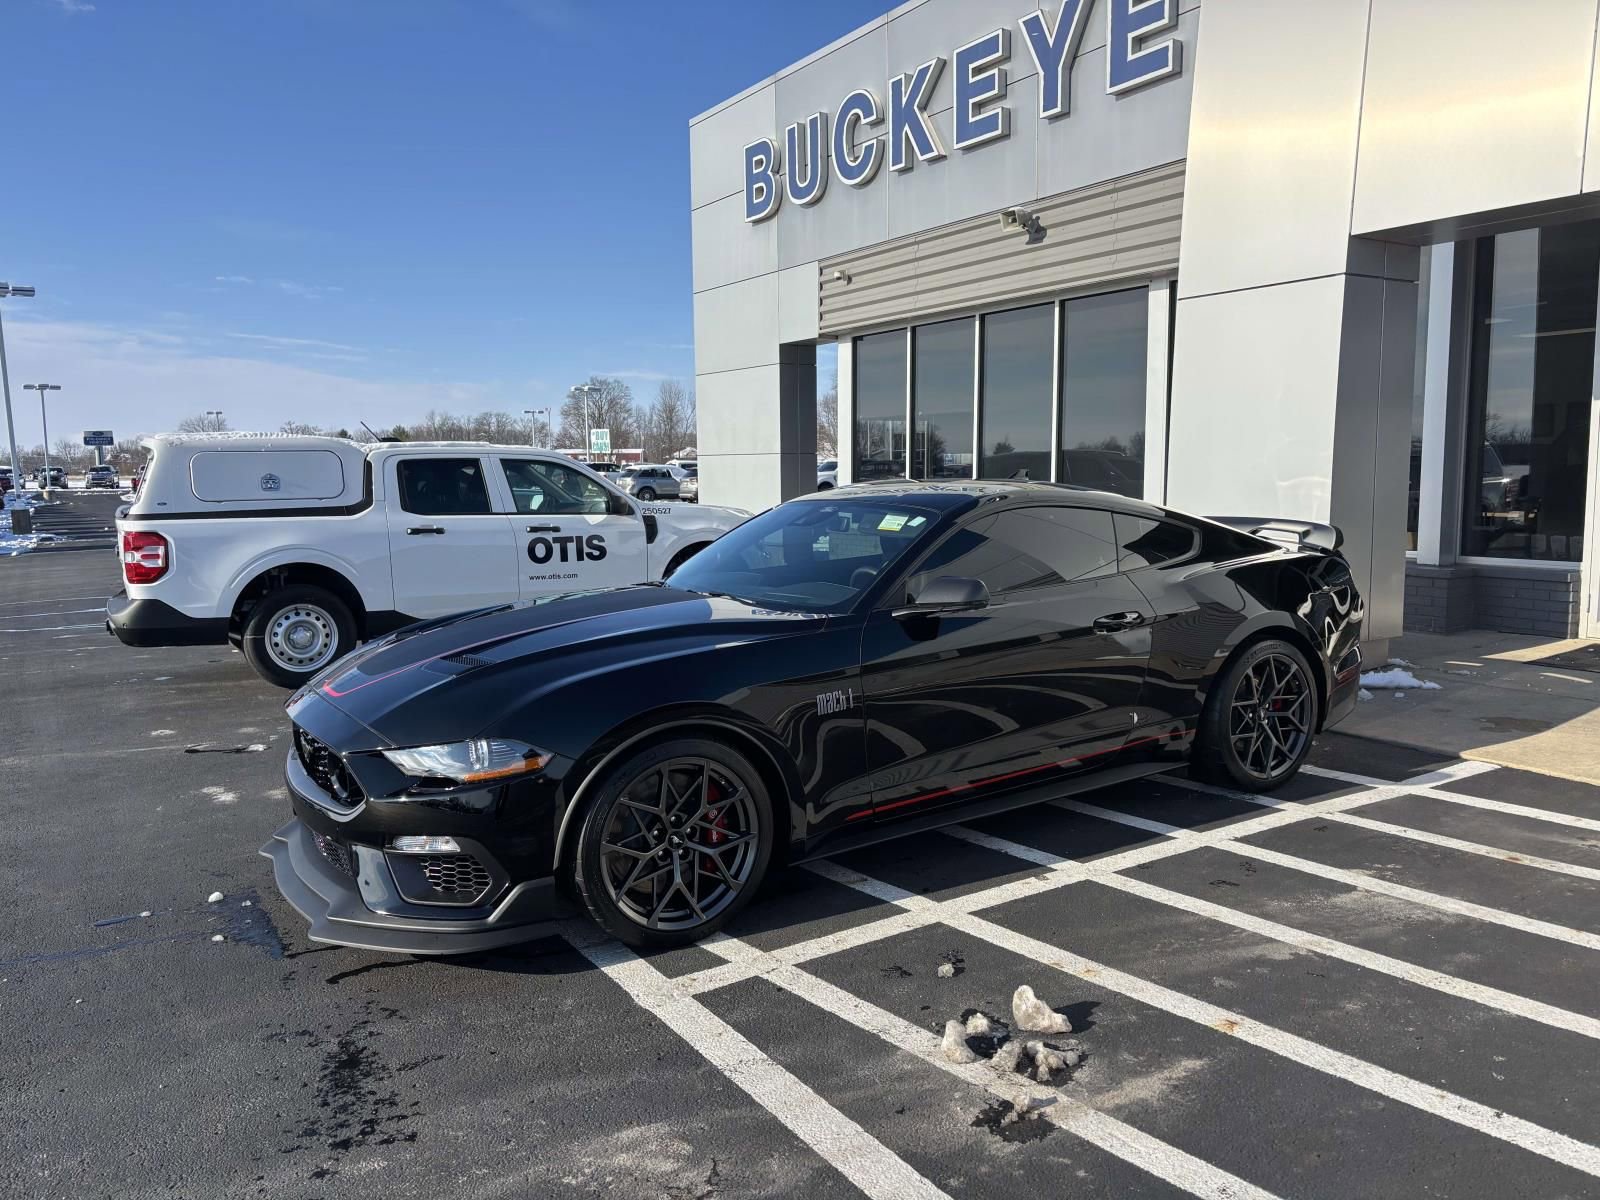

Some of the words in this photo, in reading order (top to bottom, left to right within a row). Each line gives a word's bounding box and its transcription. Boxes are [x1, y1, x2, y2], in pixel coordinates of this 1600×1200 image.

[743, 0, 1181, 223] BUCKEYE
[641, 507, 672, 515] 250527
[527, 534, 608, 565] OTIS
[528, 572, 579, 581] www.otis.com
